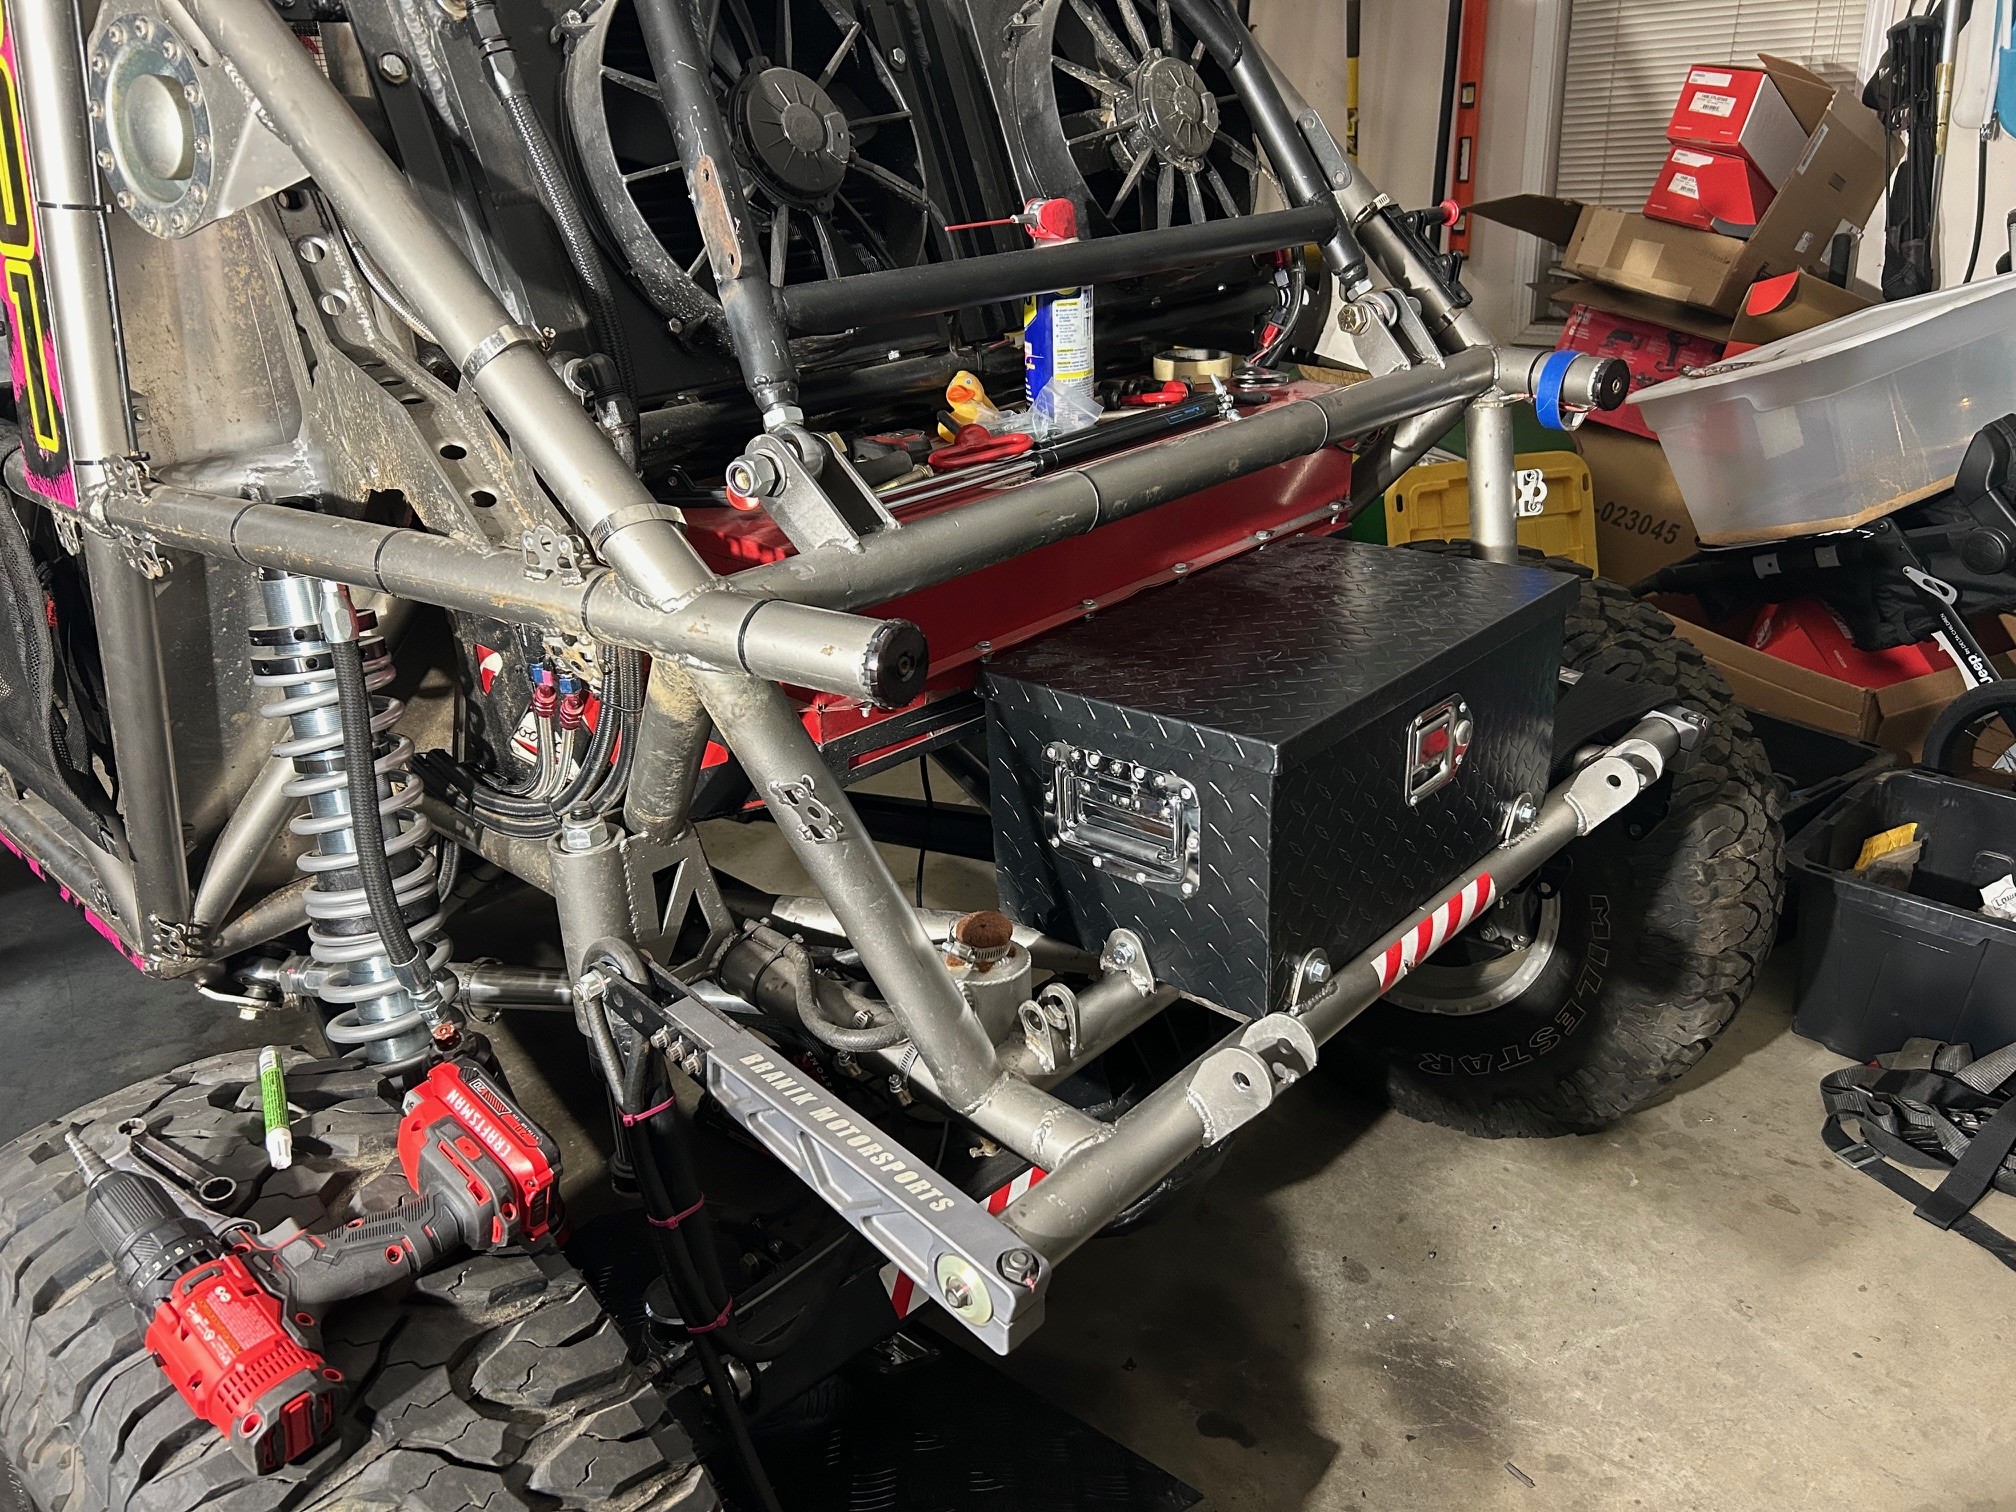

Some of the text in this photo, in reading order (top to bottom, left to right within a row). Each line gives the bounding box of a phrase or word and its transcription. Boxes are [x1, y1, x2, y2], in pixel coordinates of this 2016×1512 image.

[1954, 635, 1967, 649] DELTA
[1967, 654, 1994, 684] Jeep
[1418, 895, 1611, 1076] MILESTAR
[446, 1089, 512, 1158] CRAFTSMAN
[739, 1052, 955, 1212] BRANIK MOTORSPORTS
